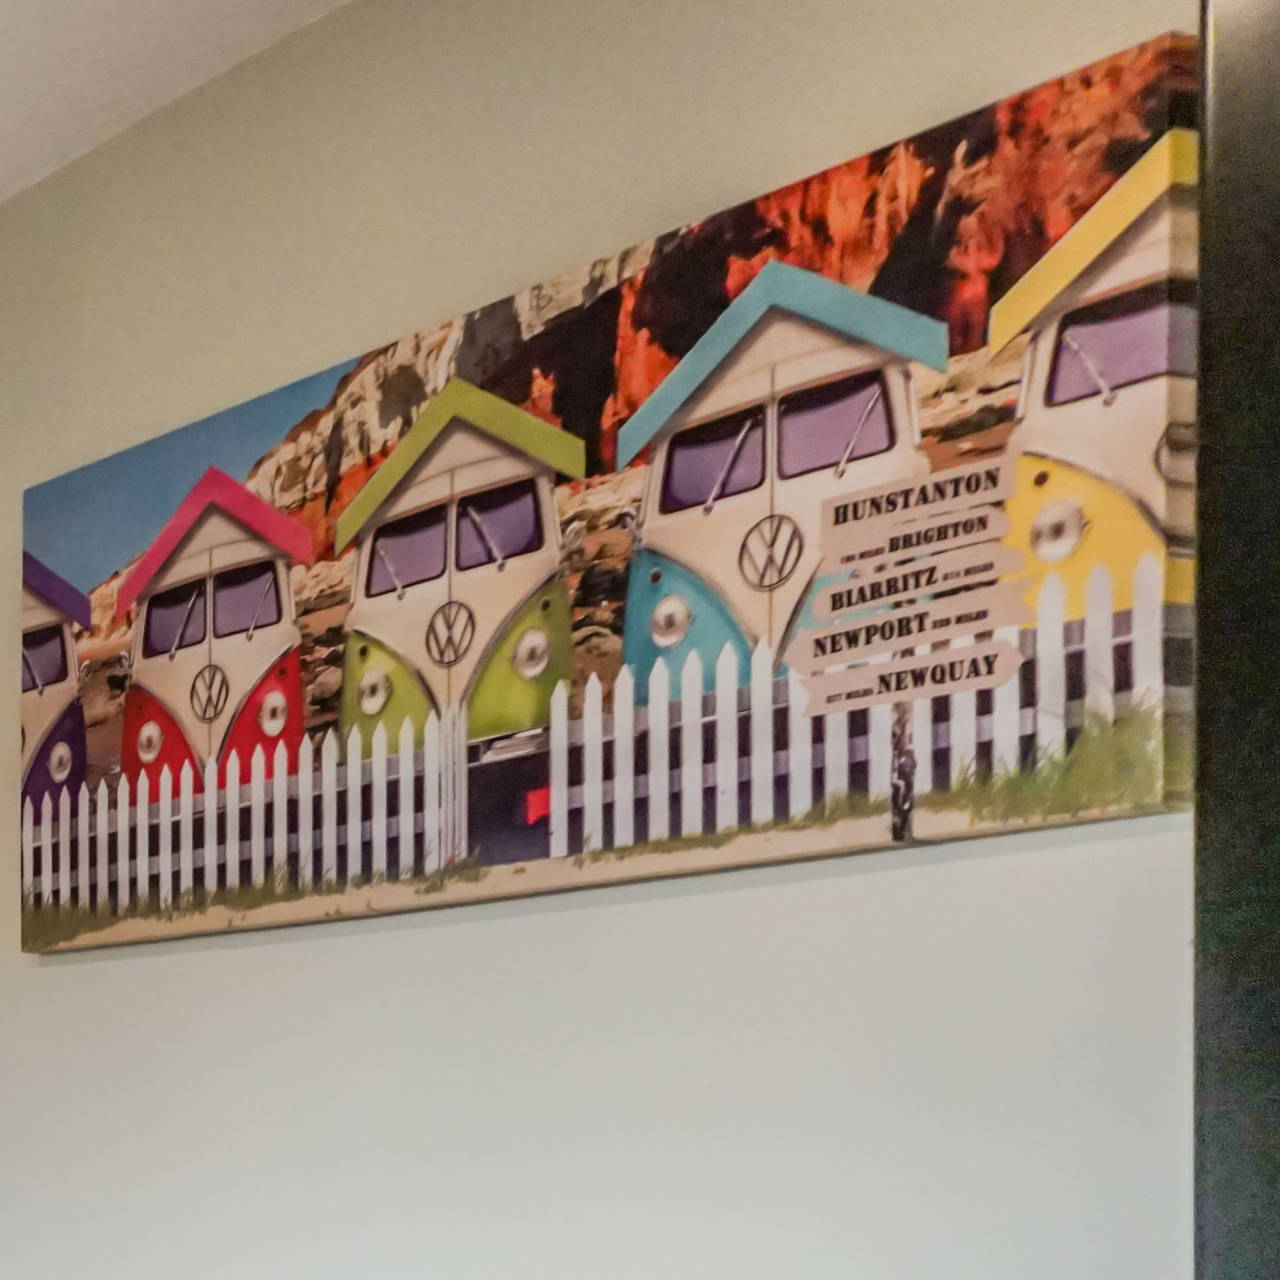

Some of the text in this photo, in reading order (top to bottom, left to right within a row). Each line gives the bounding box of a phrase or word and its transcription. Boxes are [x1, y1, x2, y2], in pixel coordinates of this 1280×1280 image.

[832, 467, 1001, 526] HUNSTANTON
[887, 514, 990, 553] BRIGHTON
[830, 565, 939, 612] BIARRITZ
[812, 612, 931, 658] NEWPORT
[876, 653, 1000, 695] NEWQUAY
